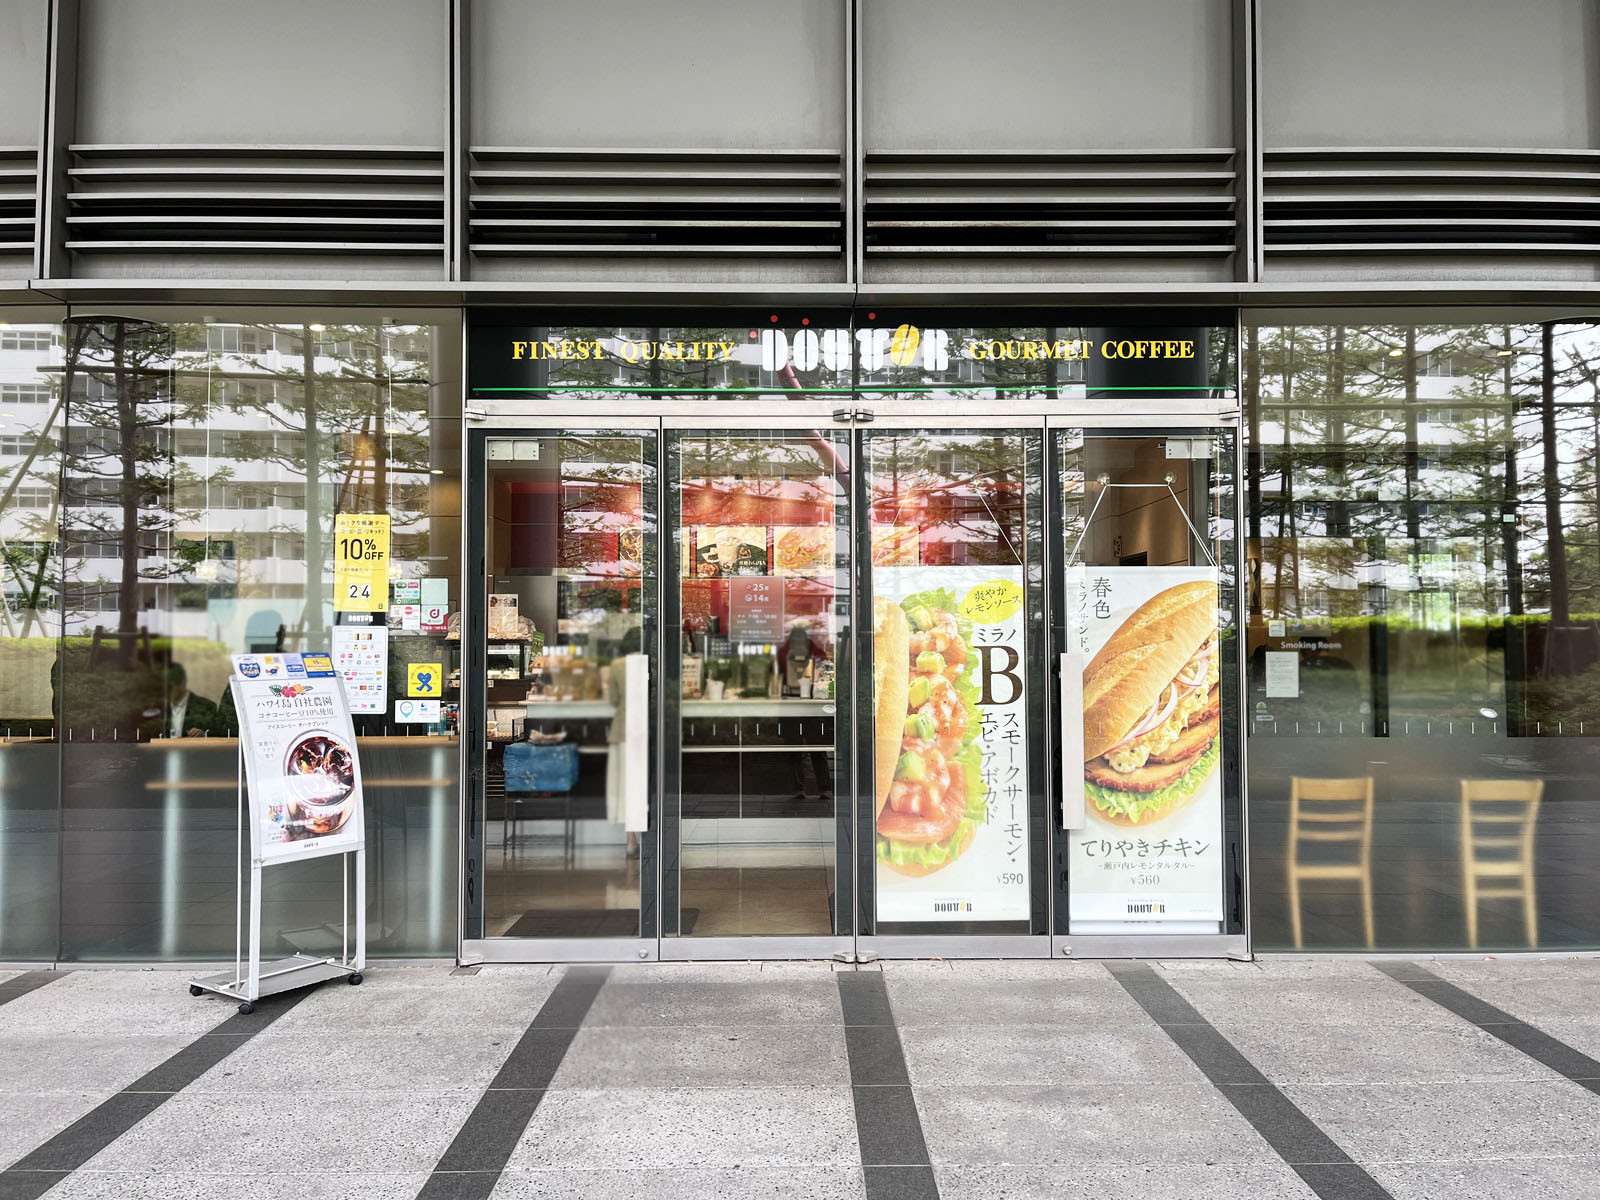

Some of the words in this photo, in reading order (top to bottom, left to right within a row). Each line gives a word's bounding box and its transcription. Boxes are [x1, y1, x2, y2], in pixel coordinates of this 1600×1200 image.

[511, 341, 605, 360] FINEST
[621, 341, 736, 364] QUALITY
[762, 324, 949, 372] DOUTOR
[969, 340, 1093, 360] GOURMET
[1101, 340, 1195, 360] COFFEE
[364, 552, 384, 560] OFF
[974, 586, 1007, 602] 爽やか
[1091, 576, 1113, 620] 春色
[966, 595, 1022, 615] レモンソース
[977, 628, 1018, 643] ミラノ
[1281, 642, 1317, 651] Smoking
[974, 645, 1023, 706] B
[1080, 837, 1211, 858] てりやきチキン
